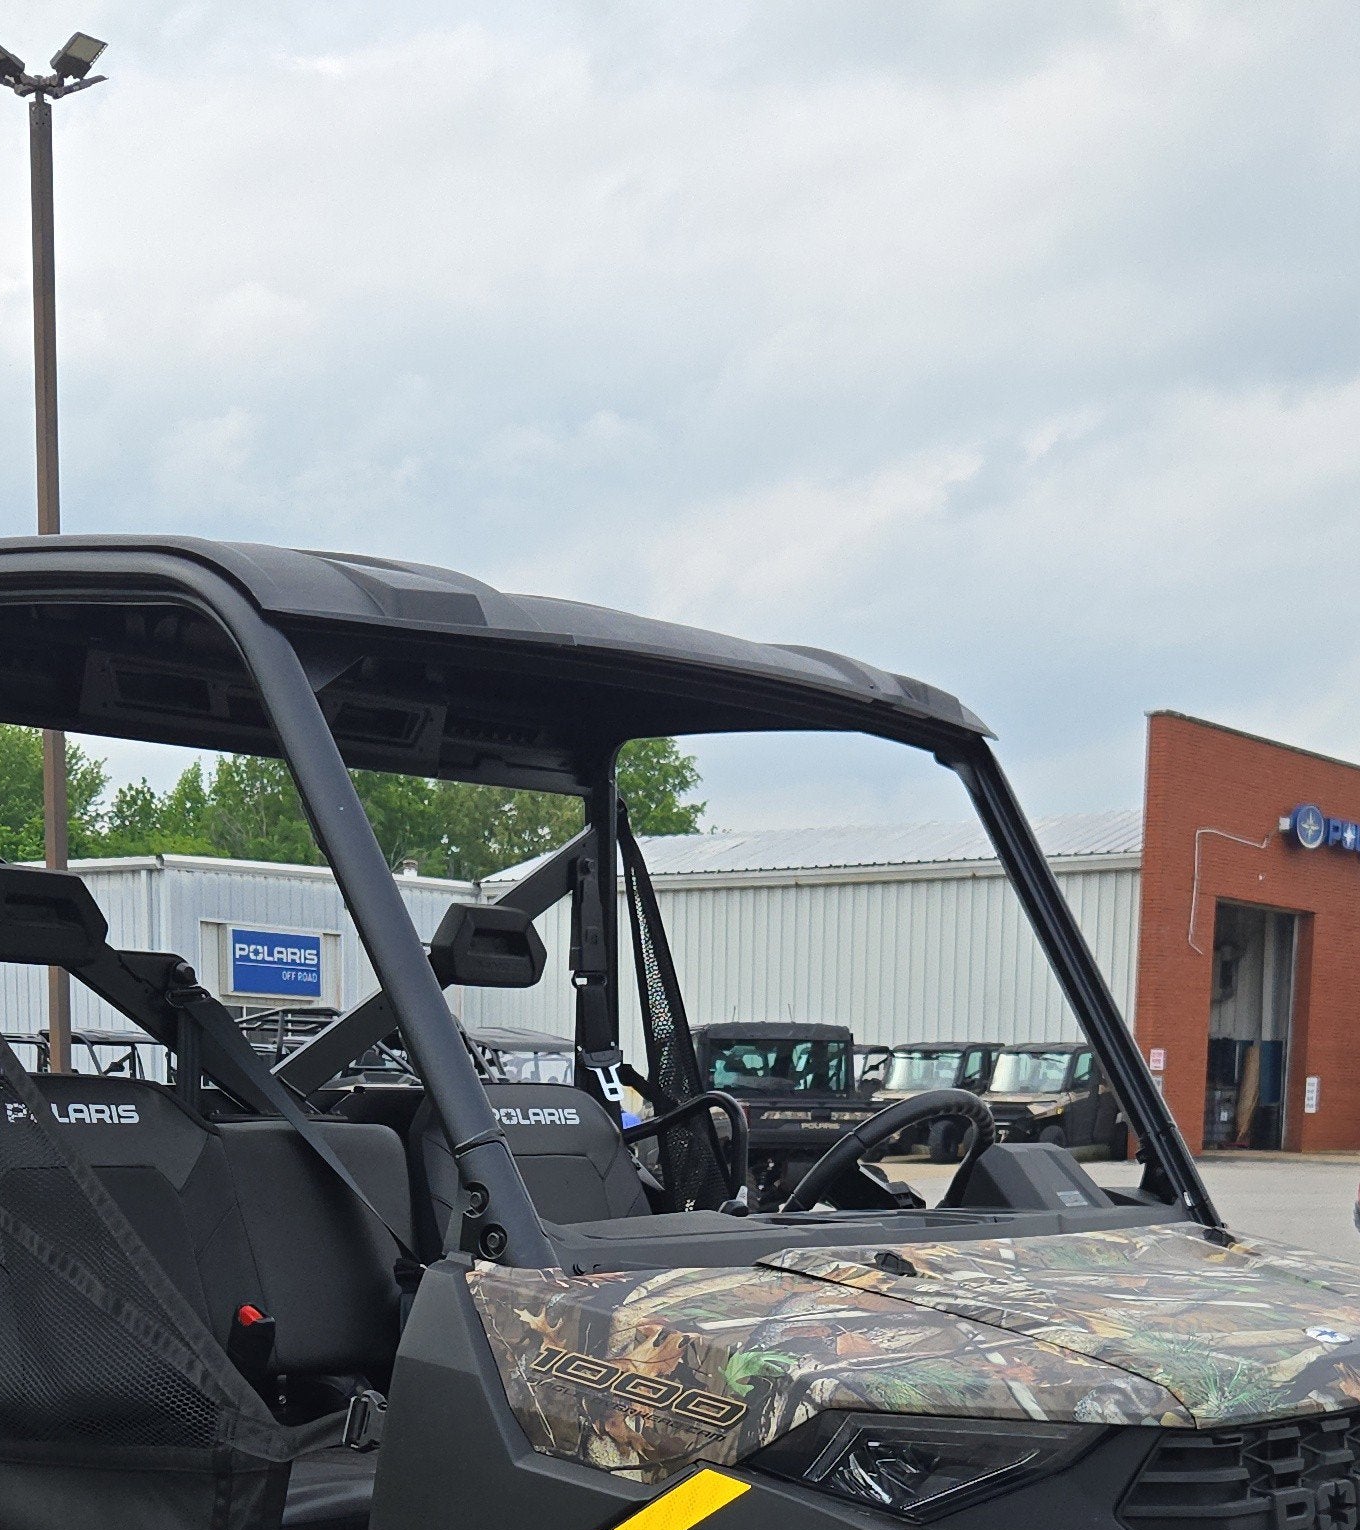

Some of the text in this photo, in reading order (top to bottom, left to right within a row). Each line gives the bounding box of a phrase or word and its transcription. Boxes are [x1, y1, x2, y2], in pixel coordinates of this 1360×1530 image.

[235, 943, 318, 965] POLARIS
[281, 971, 318, 983] OFF ROAD
[5, 1103, 140, 1124] PLARIS
[529, 1345, 748, 1427] 1000
